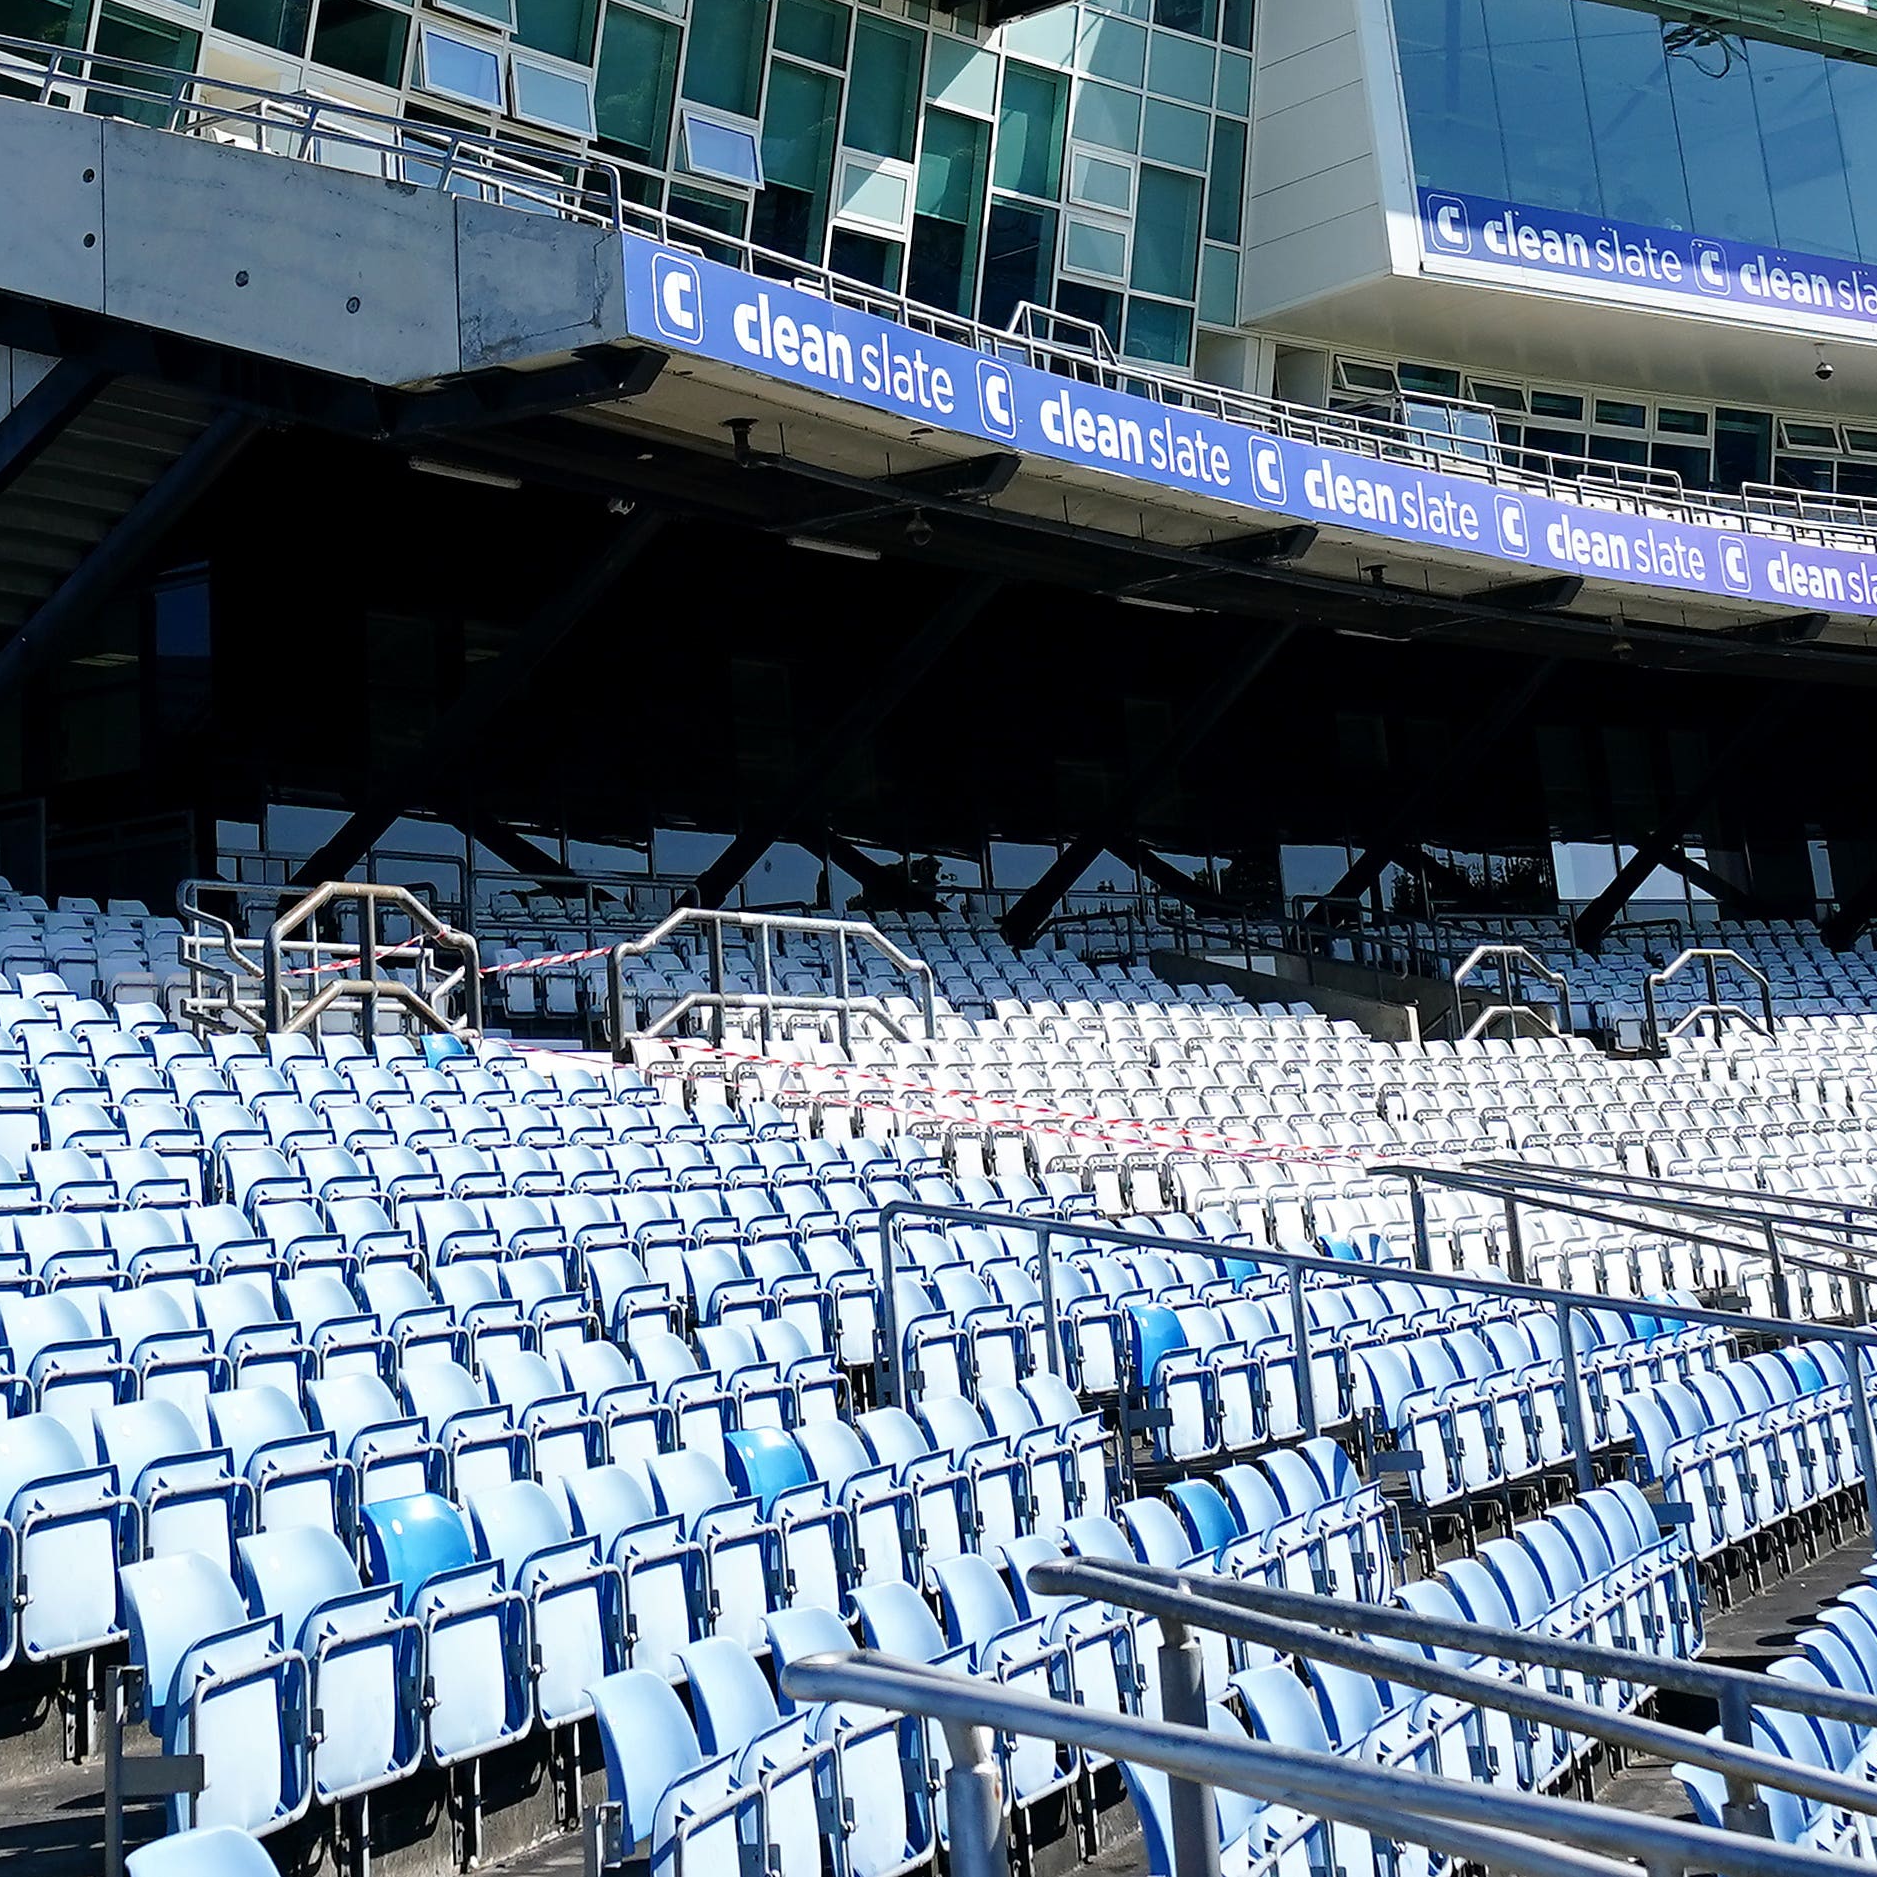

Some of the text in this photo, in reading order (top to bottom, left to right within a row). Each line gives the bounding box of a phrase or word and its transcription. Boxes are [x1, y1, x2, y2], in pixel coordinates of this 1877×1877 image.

[1437, 206, 1464, 245] C
[1483, 211, 1591, 269] clean
[1595, 229, 1683, 283] slate
[1699, 250, 1724, 287] C
[1740, 255, 1835, 309] clean
[662, 270, 694, 330] C
[733, 292, 854, 384] clean
[861, 332, 955, 414] slate
[985, 375, 1010, 426] C
[1039, 389, 1145, 465] clean
[1148, 417, 1231, 487] slate
[1256, 448, 1281, 494] C
[1303, 458, 1398, 525] clean
[1401, 480, 1480, 541] slate
[1501, 506, 1524, 548] C
[1546, 513, 1631, 571] clean
[1633, 528, 1706, 581] slate
[1725, 546, 1747, 584] C
[1767, 550, 1846, 601] clean
